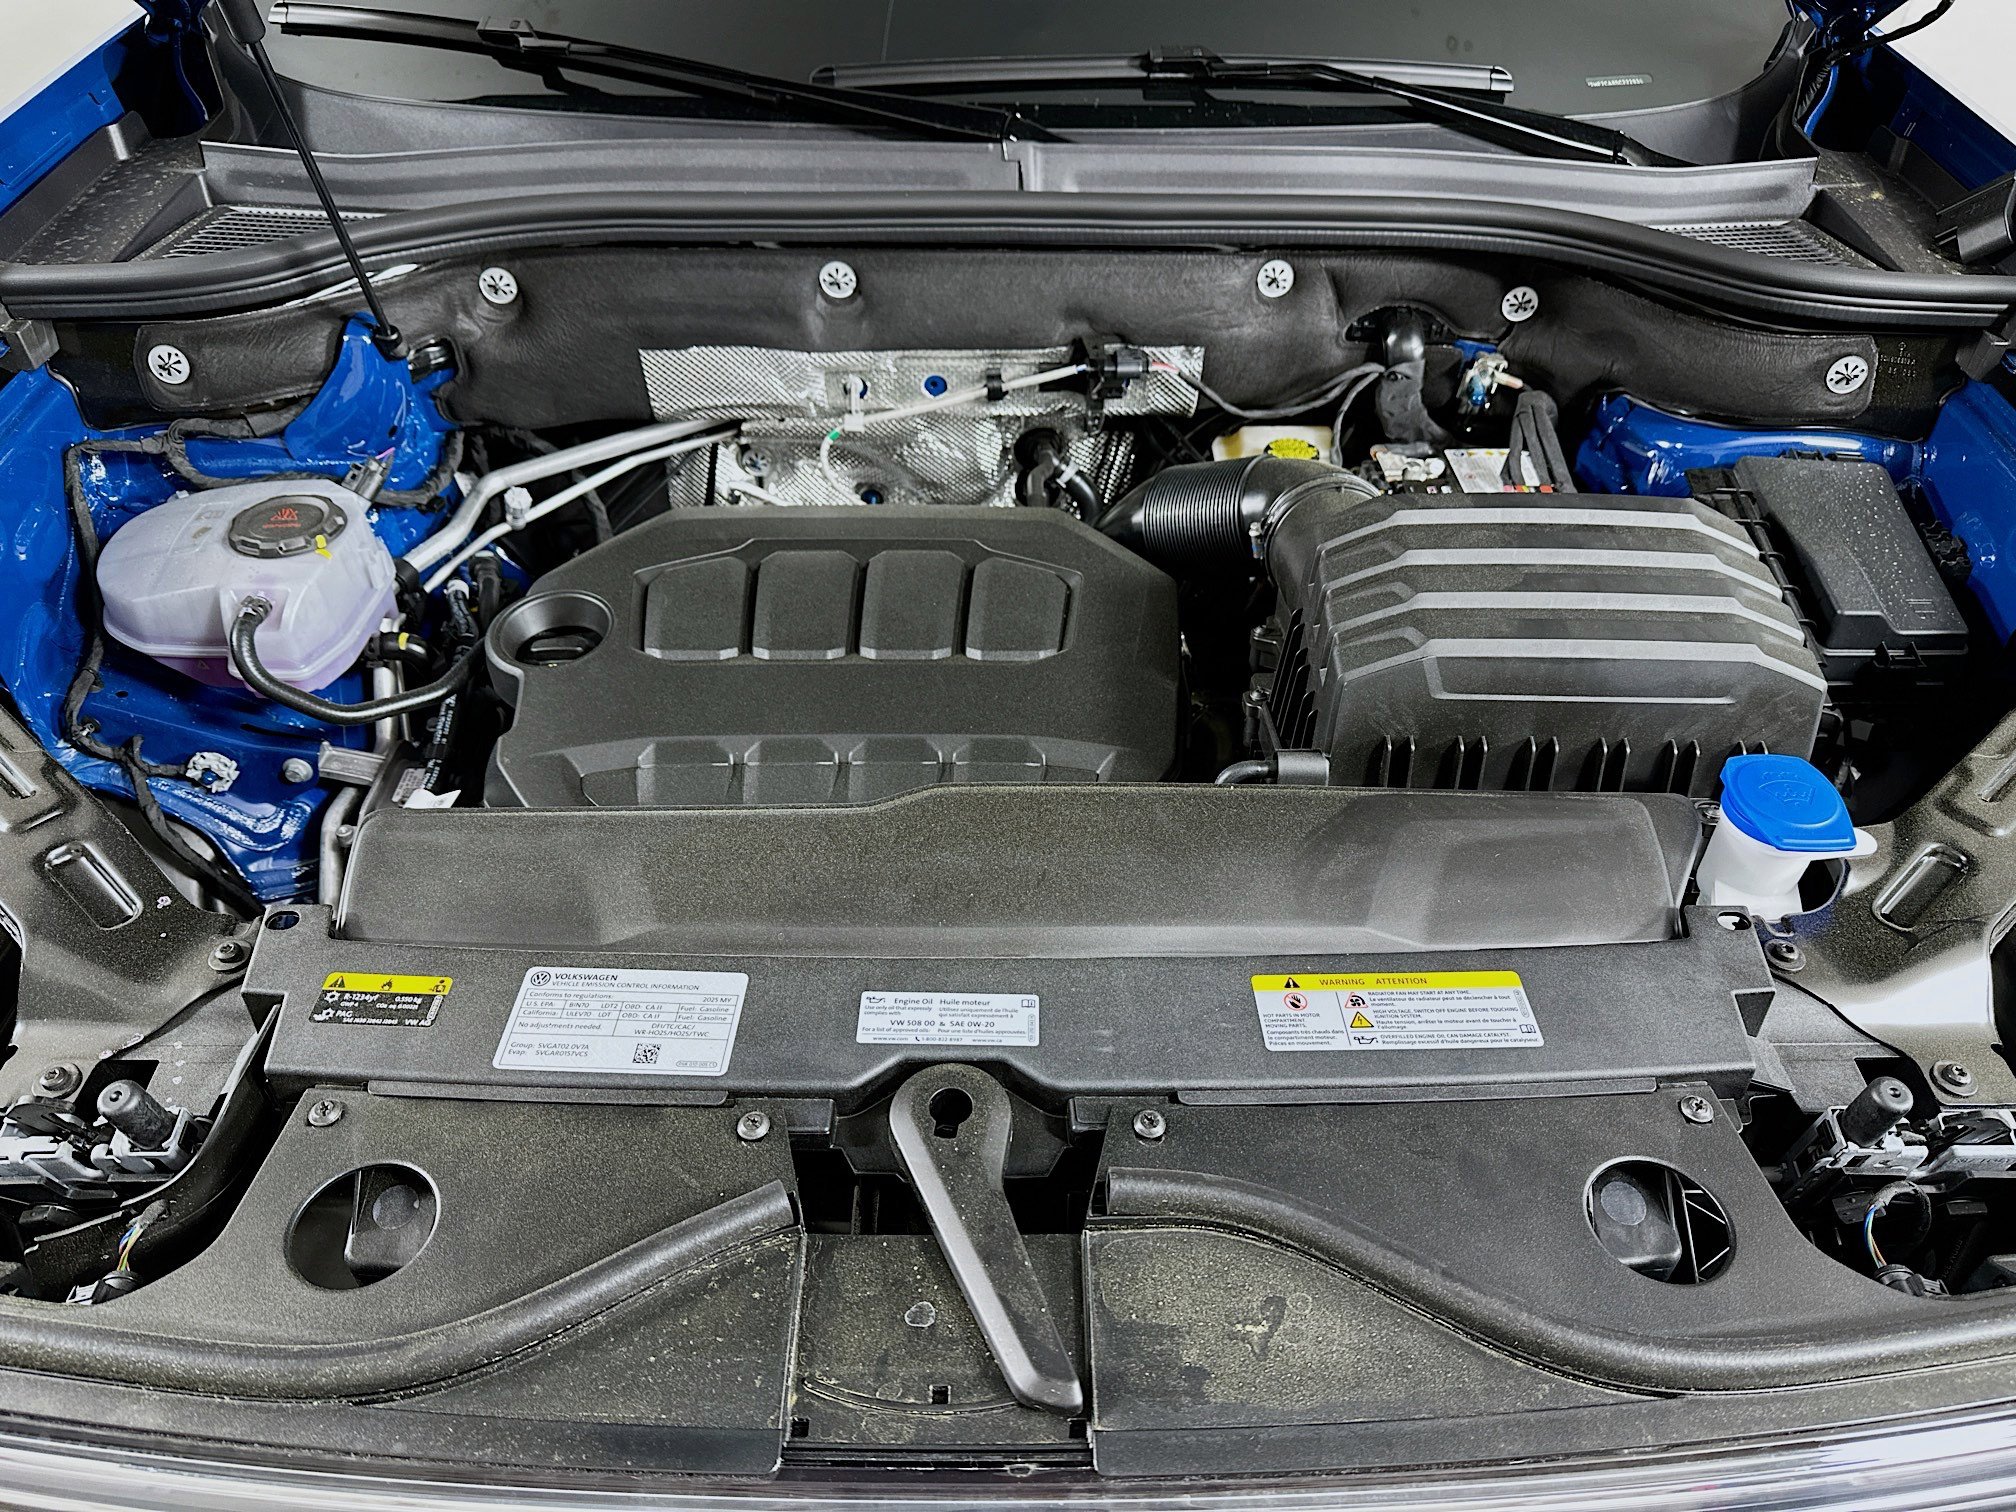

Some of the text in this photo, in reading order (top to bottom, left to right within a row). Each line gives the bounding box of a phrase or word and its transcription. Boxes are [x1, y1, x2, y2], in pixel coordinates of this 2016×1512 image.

[555, 973, 618, 981] VOLKSWAGEN
[1319, 977, 1428, 986] WARNING ATTENTION
[343, 993, 379, 1003] R-1234yf
[413, 996, 423, 1004] kg
[405, 1018, 419, 1026] VW
[697, 1014, 727, 1022] Gasoline
[510, 1041, 535, 1049] Group:
[508, 1048, 527, 1056] Evap:
